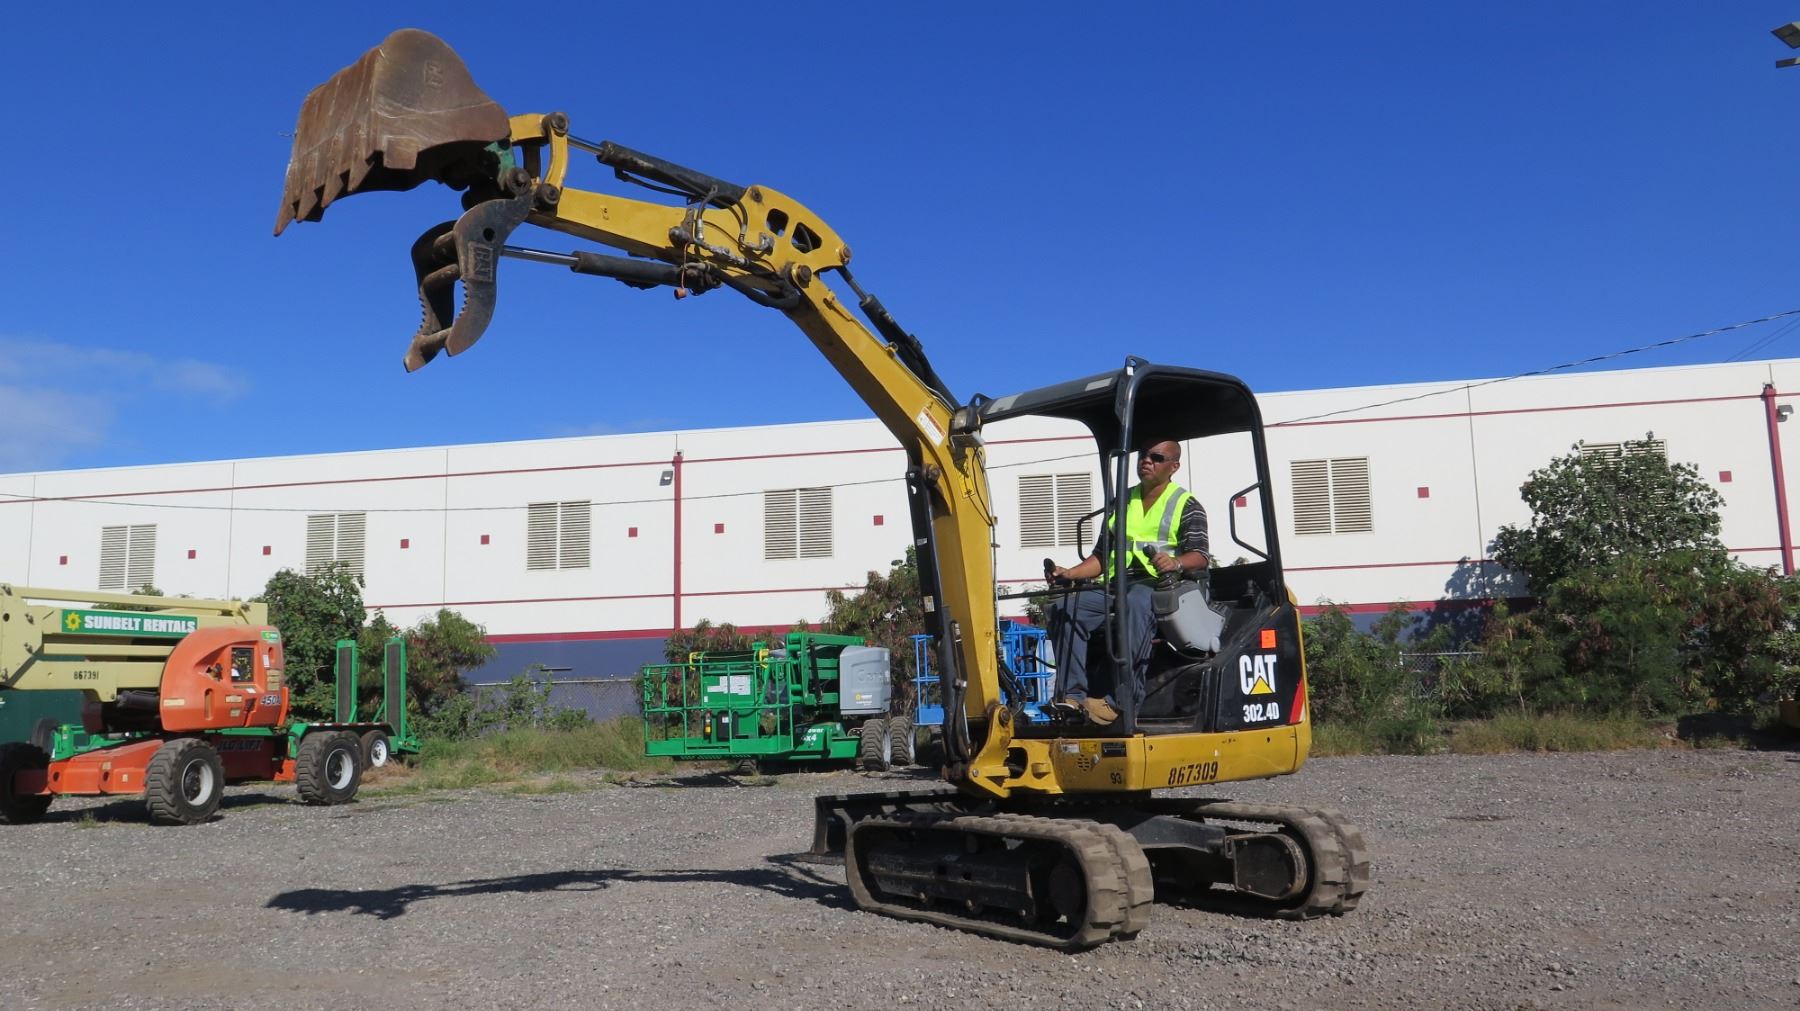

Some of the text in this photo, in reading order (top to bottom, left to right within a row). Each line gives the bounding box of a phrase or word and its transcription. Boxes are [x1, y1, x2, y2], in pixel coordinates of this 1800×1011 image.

[84, 615, 196, 633] SUNBELT RENTALS
[1239, 654, 1277, 696] CAT
[1242, 702, 1280, 723] 302.4D
[1110, 771, 1122, 785] 93
[1167, 761, 1219, 786] 867309
